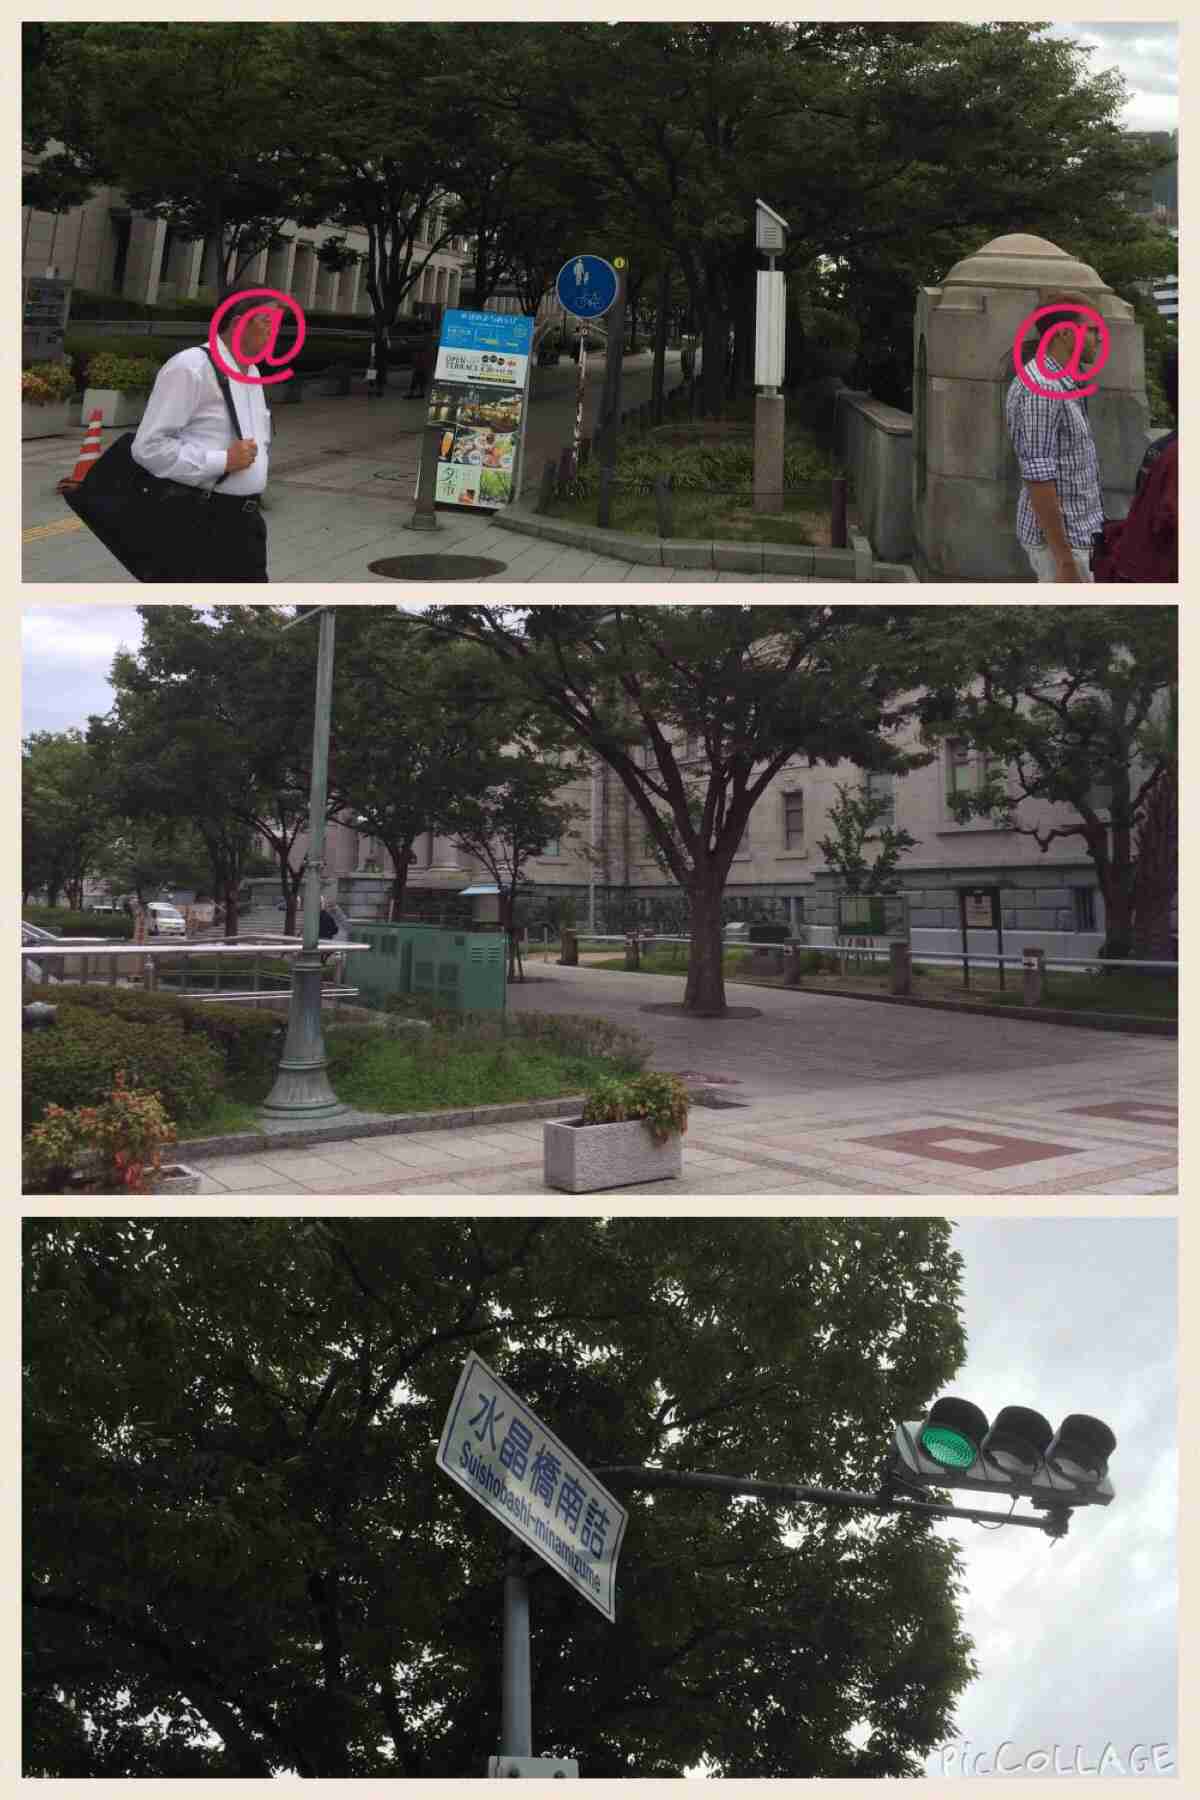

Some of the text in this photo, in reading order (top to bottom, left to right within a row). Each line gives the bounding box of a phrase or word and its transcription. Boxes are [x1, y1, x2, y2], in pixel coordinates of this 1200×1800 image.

[459, 1439, 601, 1593] Suishobashi-minamizume
[468, 1393, 611, 1558] 水晶橋南詰
